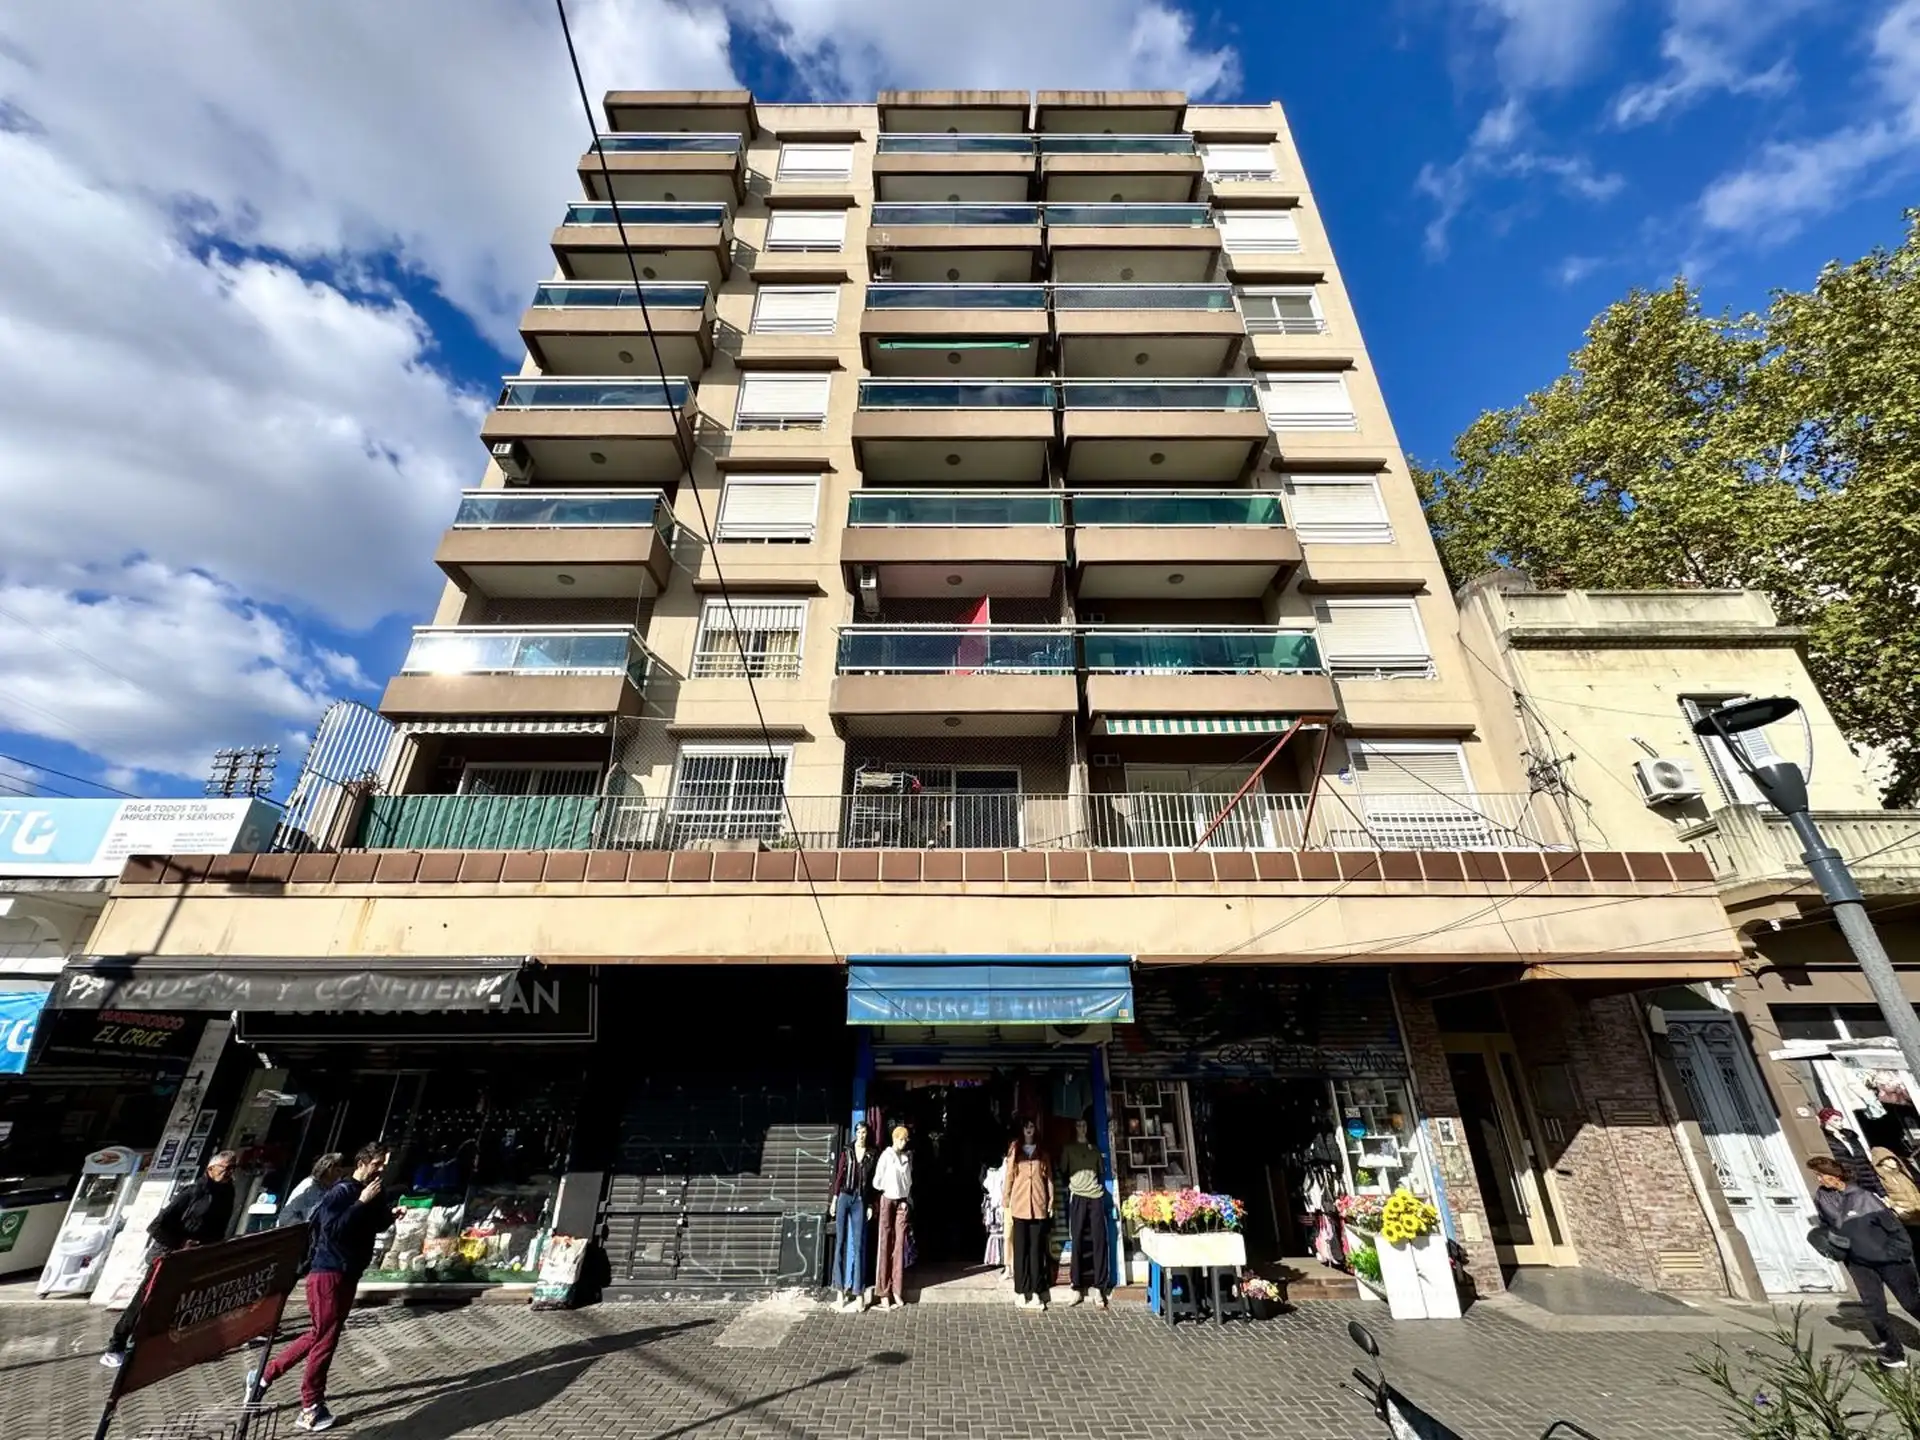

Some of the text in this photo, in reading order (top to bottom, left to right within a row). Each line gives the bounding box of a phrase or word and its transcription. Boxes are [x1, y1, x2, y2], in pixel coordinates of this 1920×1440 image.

[153, 804, 187, 813] TODOS
[190, 804, 208, 813] TUS
[120, 812, 236, 821] IMPUESTOS Y SERVICIOS
[92, 1025, 172, 1048] EL CRUCE
